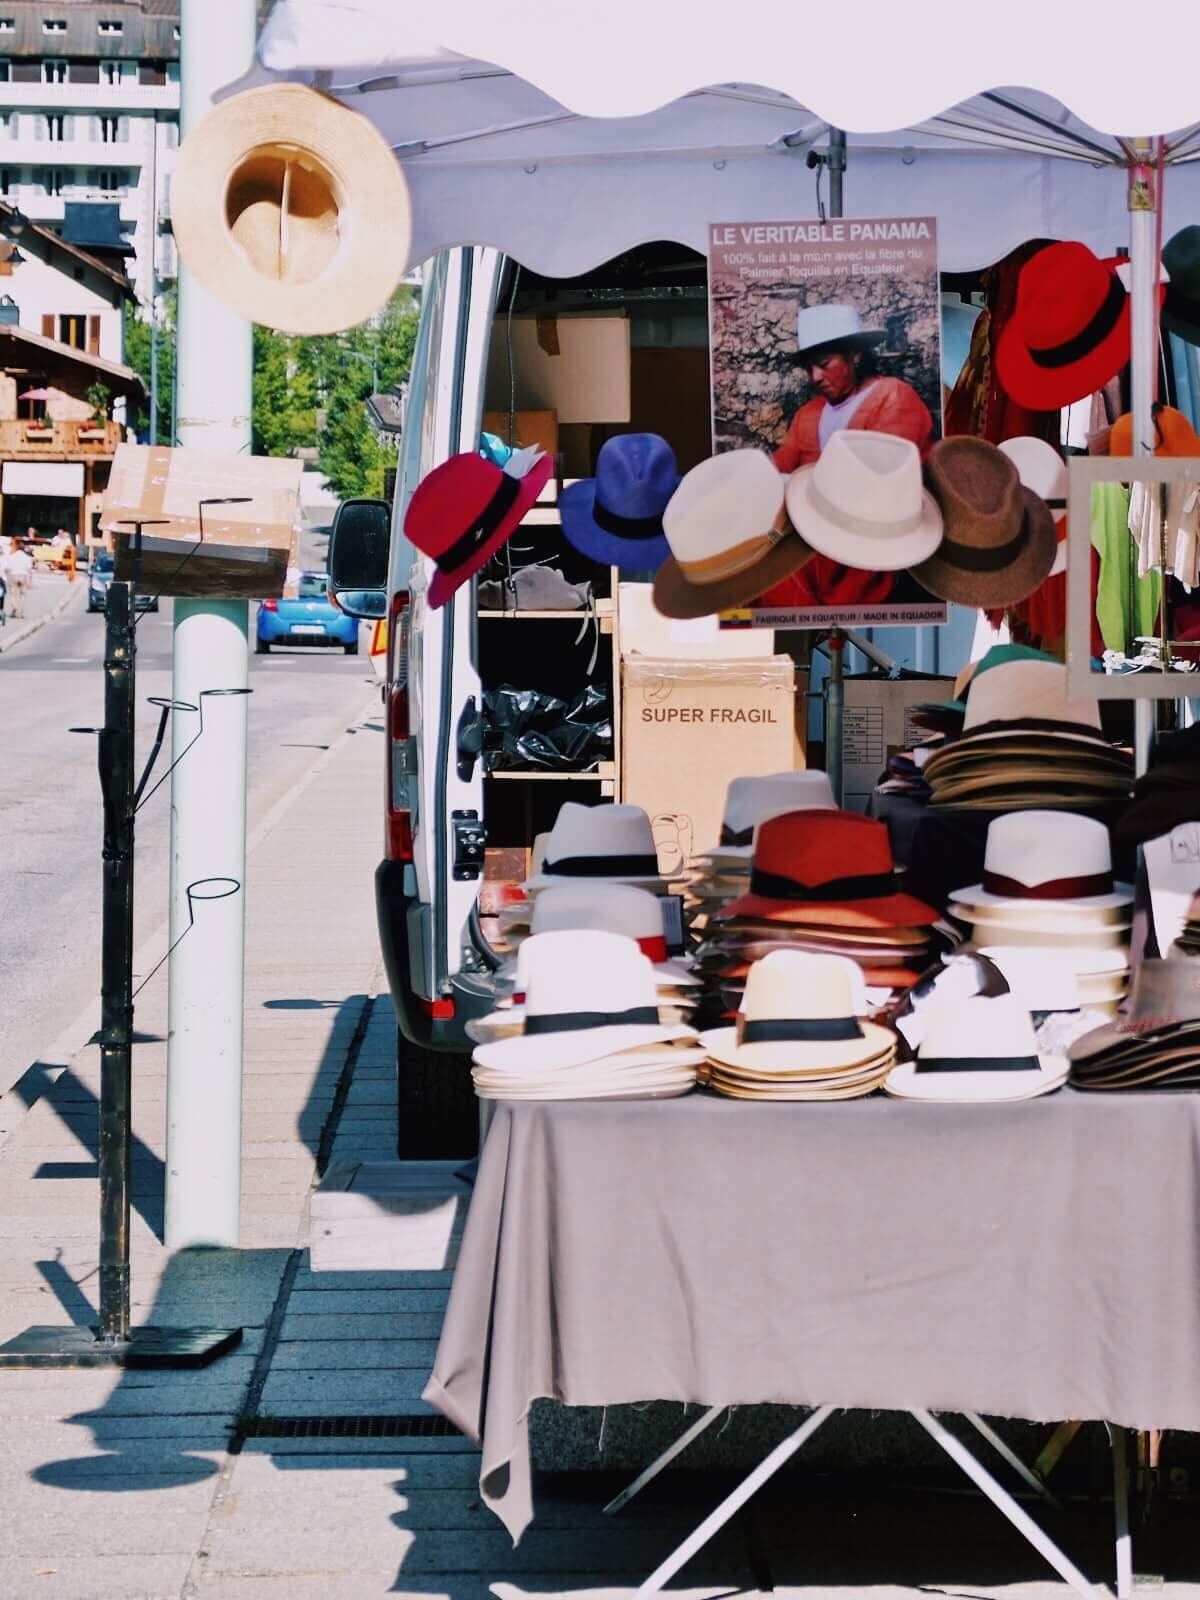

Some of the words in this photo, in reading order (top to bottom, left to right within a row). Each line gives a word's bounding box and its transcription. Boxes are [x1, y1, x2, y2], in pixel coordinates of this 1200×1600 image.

[713, 227, 737, 245] LE
[741, 224, 845, 244] VERITABLE
[850, 222, 930, 240] PANAMA
[723, 253, 754, 264] 100%
[758, 252, 776, 263] fait
[789, 252, 801, 262] la
[803, 251, 831, 262] main
[834, 252, 862, 261] avec
[865, 250, 876, 260] la
[879, 248, 904, 260] fibre
[907, 248, 922, 258] du
[740, 267, 784, 278] Palmier
[786, 264, 830, 278] Toquilla
[833, 266, 848, 275] en
[852, 263, 905, 277] Equateur
[799, 614, 810, 622] EN
[812, 612, 856, 622] EQUATEUR
[863, 612, 887, 620] MADE
[890, 612, 899, 620] IN
[900, 610, 944, 620] EQUADOR
[641, 707, 704, 722] SUPER
[710, 708, 777, 723] FRAGIL
